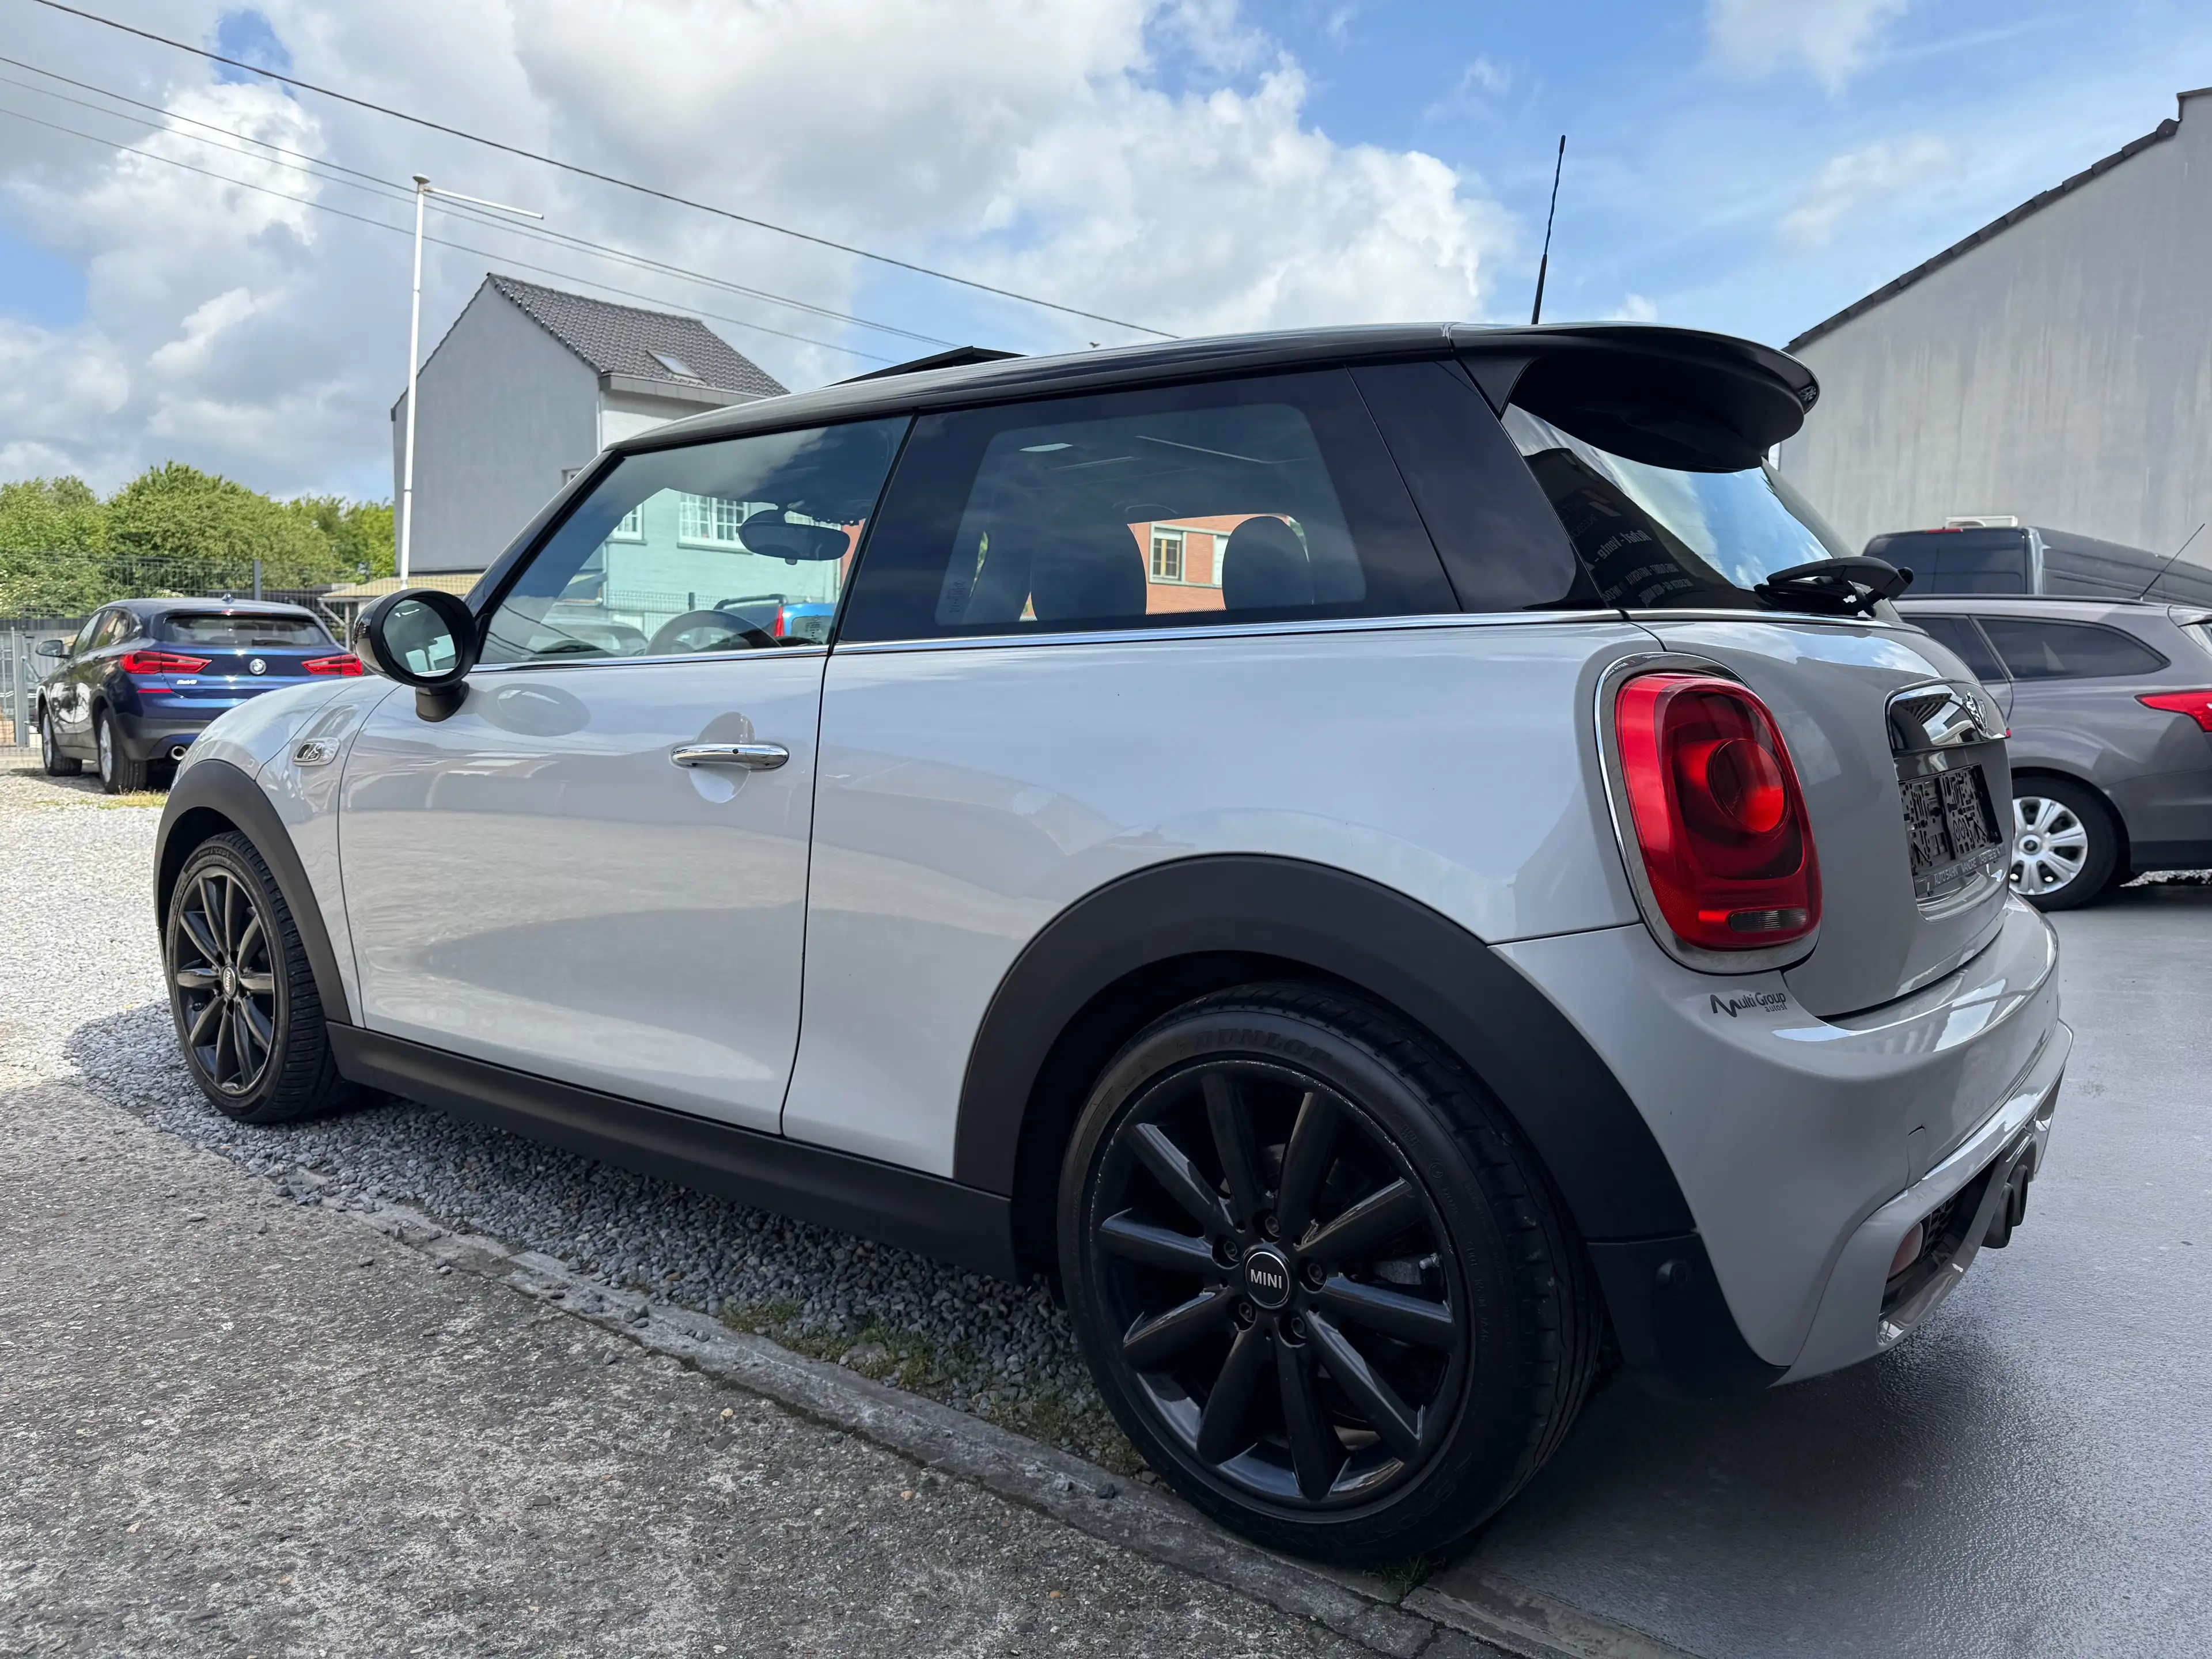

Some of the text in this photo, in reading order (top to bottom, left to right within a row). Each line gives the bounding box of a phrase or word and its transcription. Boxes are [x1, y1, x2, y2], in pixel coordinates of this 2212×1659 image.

[1764, 1005, 1785, 1013] autos
[1195, 1028, 1334, 1063] DUNLOP
[1251, 1268, 1282, 1289] MINI
